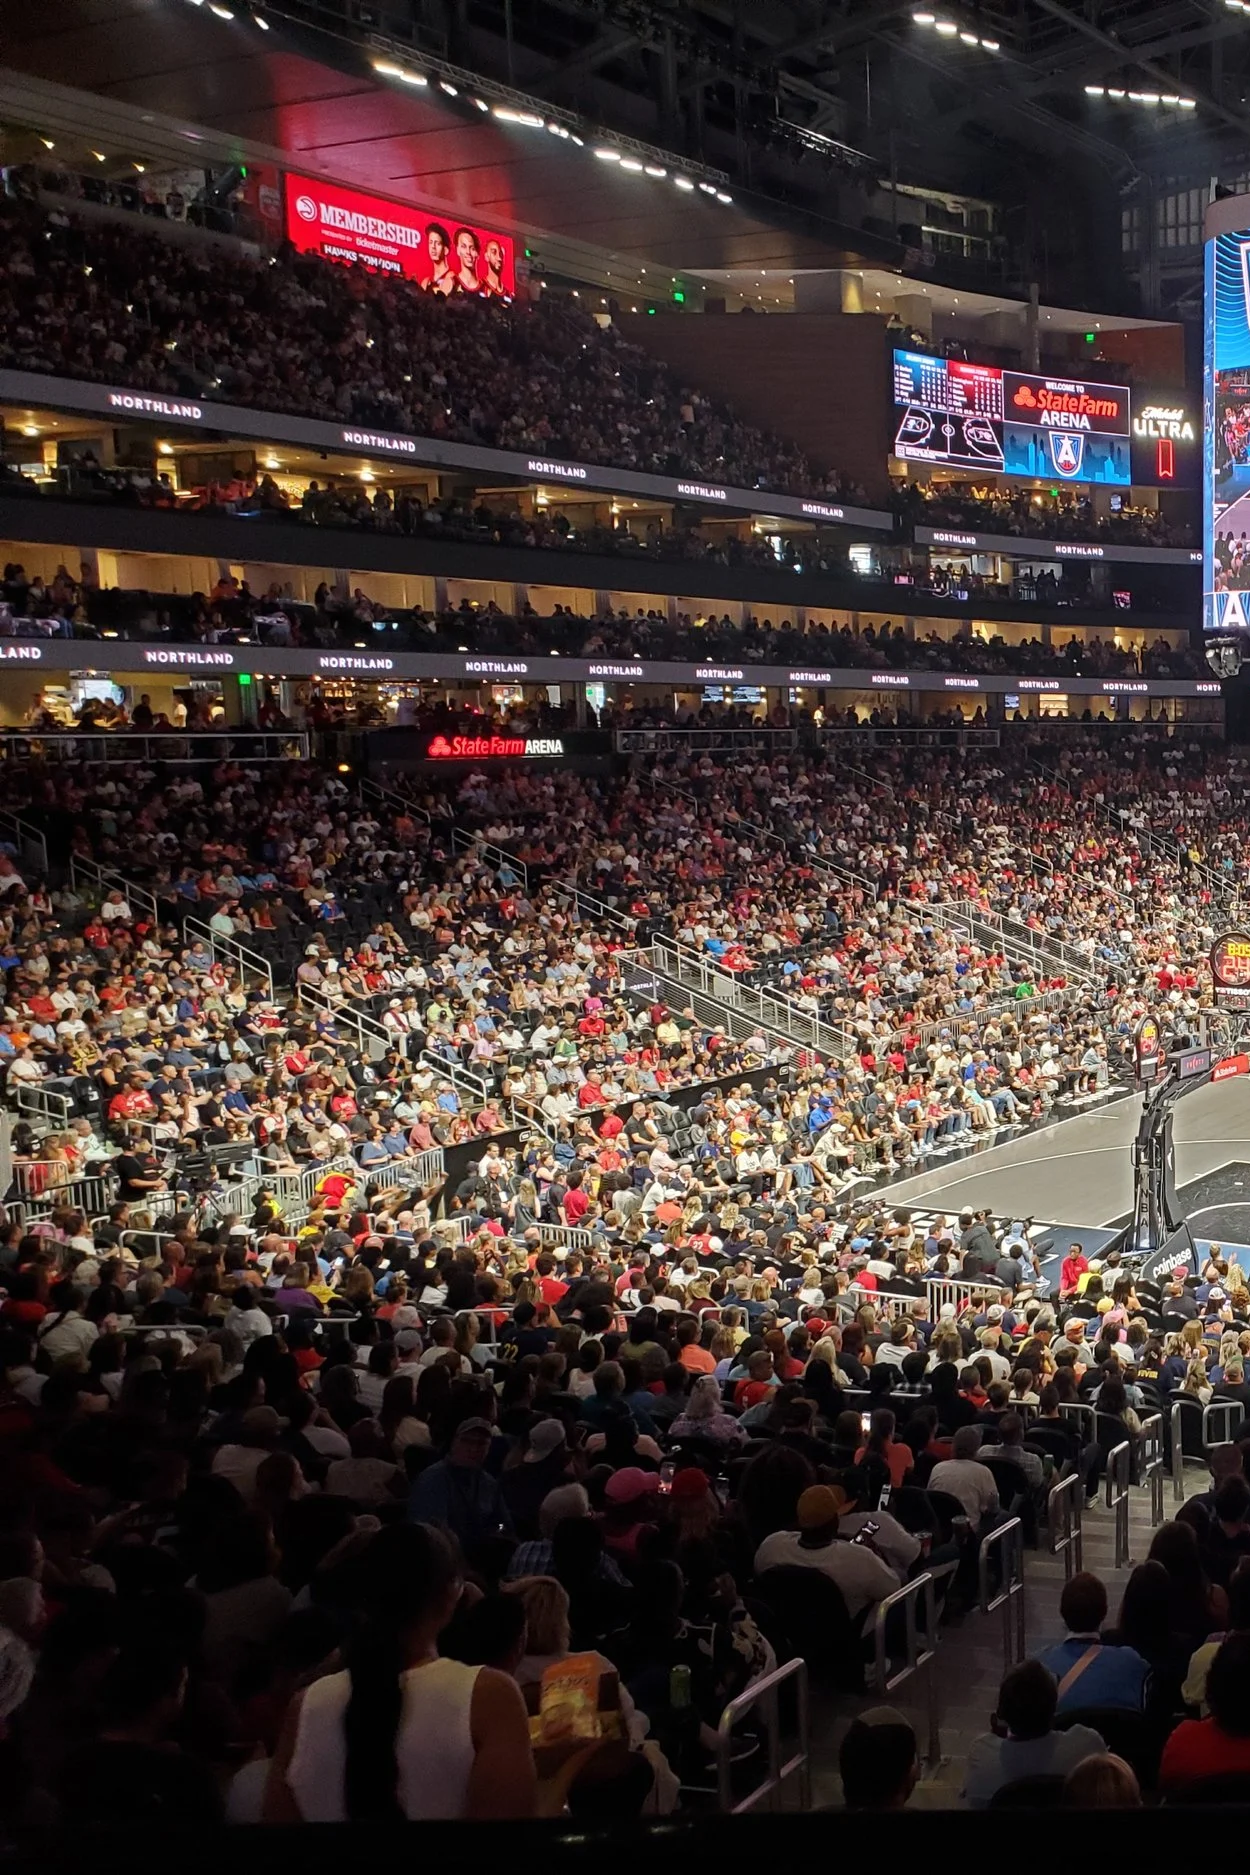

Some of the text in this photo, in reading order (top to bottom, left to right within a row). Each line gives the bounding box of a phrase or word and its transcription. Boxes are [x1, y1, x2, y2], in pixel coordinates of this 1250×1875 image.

[319, 203, 422, 248] MEMBERSHIP
[355, 237, 399, 256] ticketmaster
[1045, 381, 1085, 394] WELCOME TO
[1040, 410, 1091, 430] ARENA
[1133, 418, 1194, 440] ULTRA
[109, 394, 844, 519] NORTHLAND NORTHLAND NORTHLAND NORTHLAND NORTHLAND
[933, 532, 977, 545] NORTHLAND
[1055, 545, 1104, 557] NORTHLAND
[145, 651, 234, 665] NORTHLAND
[319, 656, 393, 670] NORTHLAND
[465, 661, 528, 673] NORTHLAND
[589, 665, 643, 676] NORTHLAND
[695, 669, 744, 680] NORTHLAND
[789, 672, 832, 684] NORTHLAND
[871, 675, 910, 685] NORTHLAND
[944, 678, 979, 688] NORTHLAND
[1018, 680, 1060, 690] NORTHLAND
[1102, 682, 1149, 692] NORTHLAND
[525, 739, 564, 755] ARENA
[1222, 955, 1250, 981] 24
[1152, 1247, 1192, 1276] coinbase
[502, 1343, 519, 1361] 22
